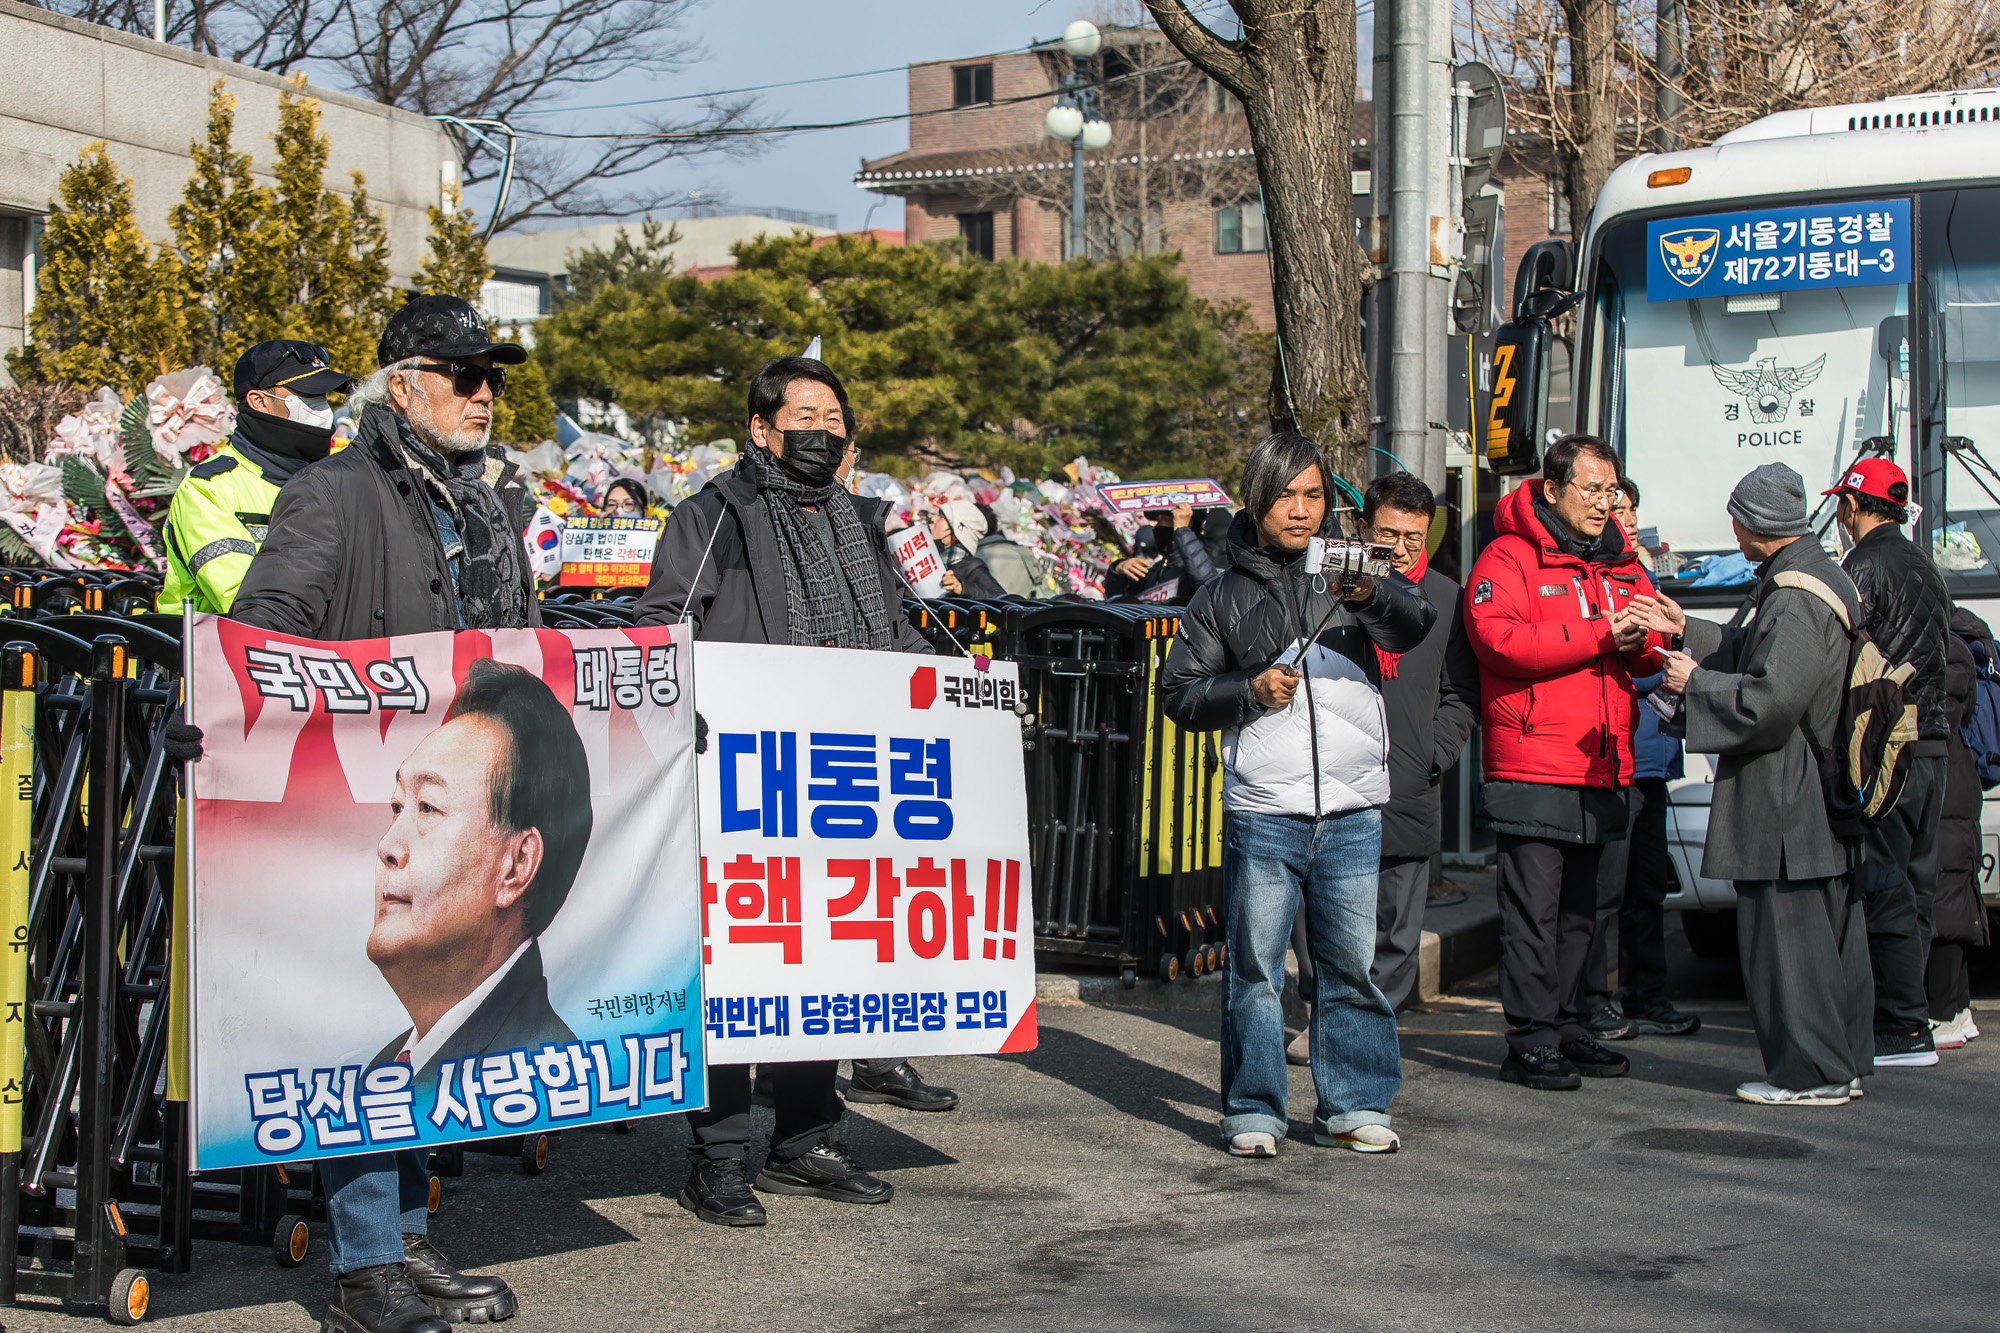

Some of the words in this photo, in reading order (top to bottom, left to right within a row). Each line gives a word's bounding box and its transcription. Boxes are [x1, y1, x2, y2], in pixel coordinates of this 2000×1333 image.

[1725, 212, 1894, 251] 서울기동경찰
[1677, 266, 1702, 276] POLICE
[1723, 248, 1896, 285] 제72기동대-3
[1724, 403, 1739, 421] 경
[1799, 399, 1815, 416] 찰
[1737, 430, 1802, 447] POLICE
[583, 548, 613, 561] 탄핵은
[597, 533, 627, 546] 법이면
[244, 645, 429, 715] 국민의
[572, 643, 680, 711] 대통령
[943, 675, 1016, 711] 국민의힘
[718, 730, 954, 840] 대통령
[827, 857, 1021, 963] 각하!!
[586, 988, 687, 1021] 국민희망저널
[800, 992, 947, 1035] 당협위원장
[956, 990, 1008, 1029] 모임
[245, 1062, 420, 1156] 당신을
[427, 1028, 690, 1132] 사랑합니다
